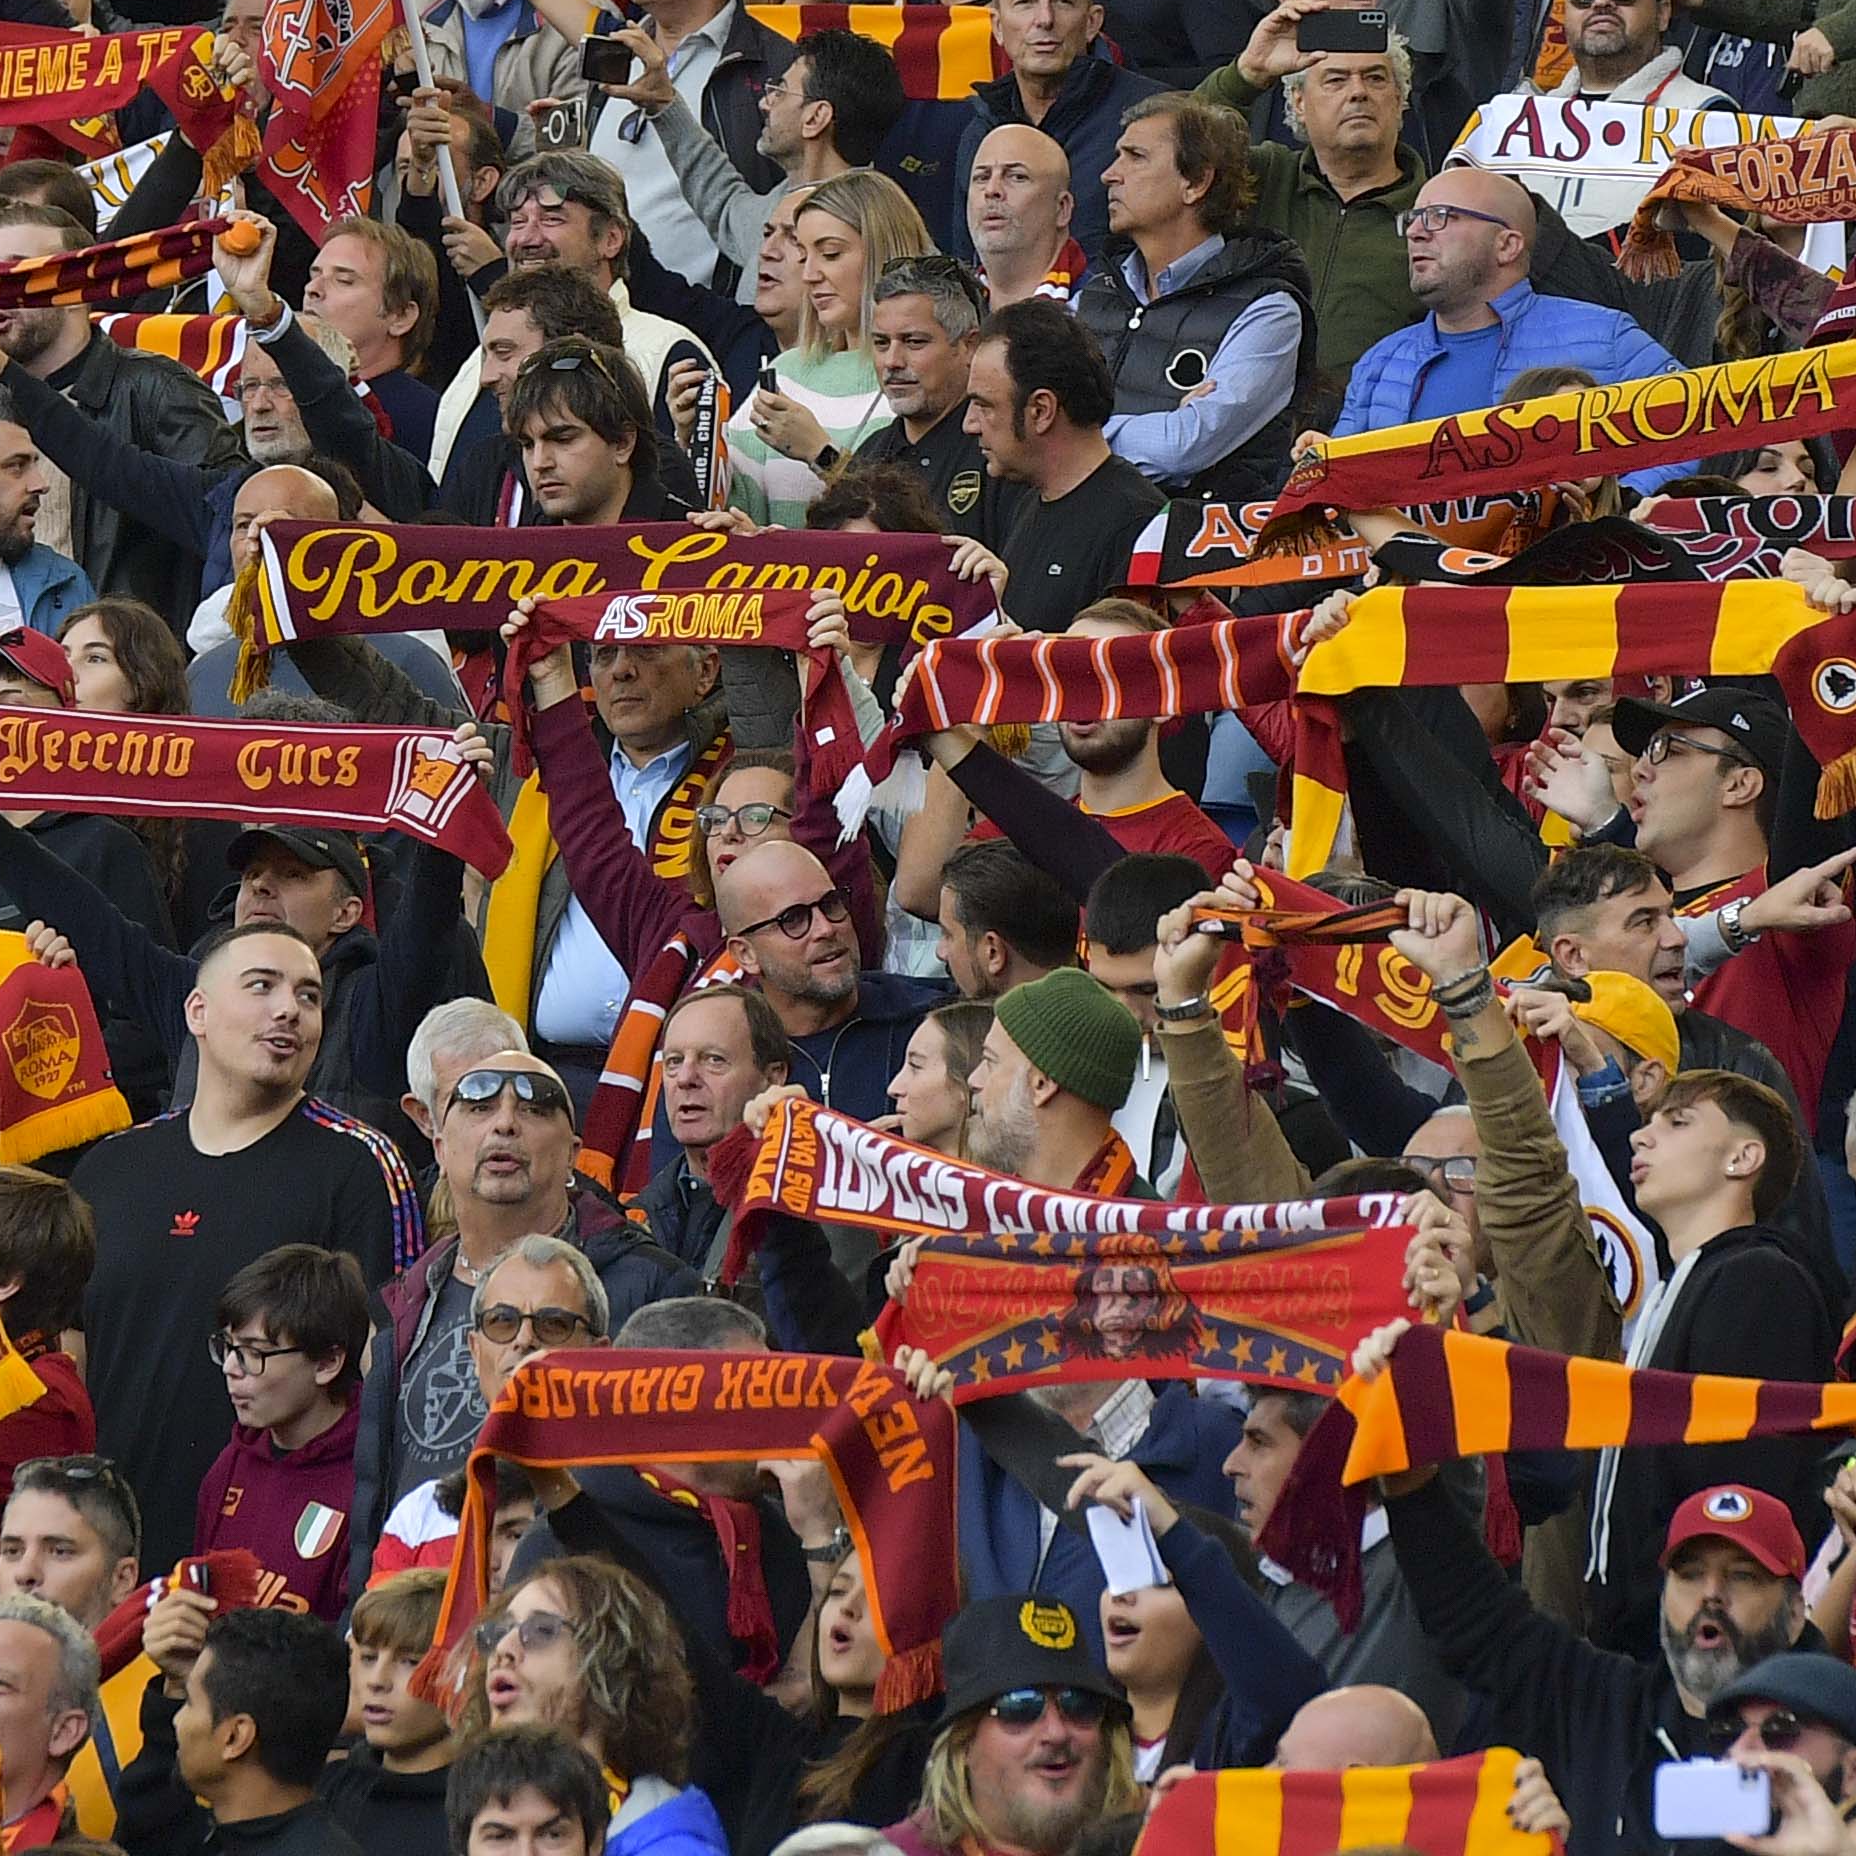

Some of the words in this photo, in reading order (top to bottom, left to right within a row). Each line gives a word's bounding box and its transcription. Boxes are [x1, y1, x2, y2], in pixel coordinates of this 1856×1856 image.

[93, 37, 124, 90] A
[136, 29, 184, 83] TE
[1496, 94, 1592, 163] AS
[1776, 193, 1830, 211] DOVERE
[1424, 405, 1523, 477] AS
[1574, 350, 1838, 455] ROMA
[287, 526, 607, 622] Roma
[593, 593, 764, 642] ASROMA
[18, 1048, 75, 1083] ROMA
[33, 1070, 62, 1087] 1927
[721, 1362, 840, 1409] YORK
[844, 1366, 937, 1494] NEW
